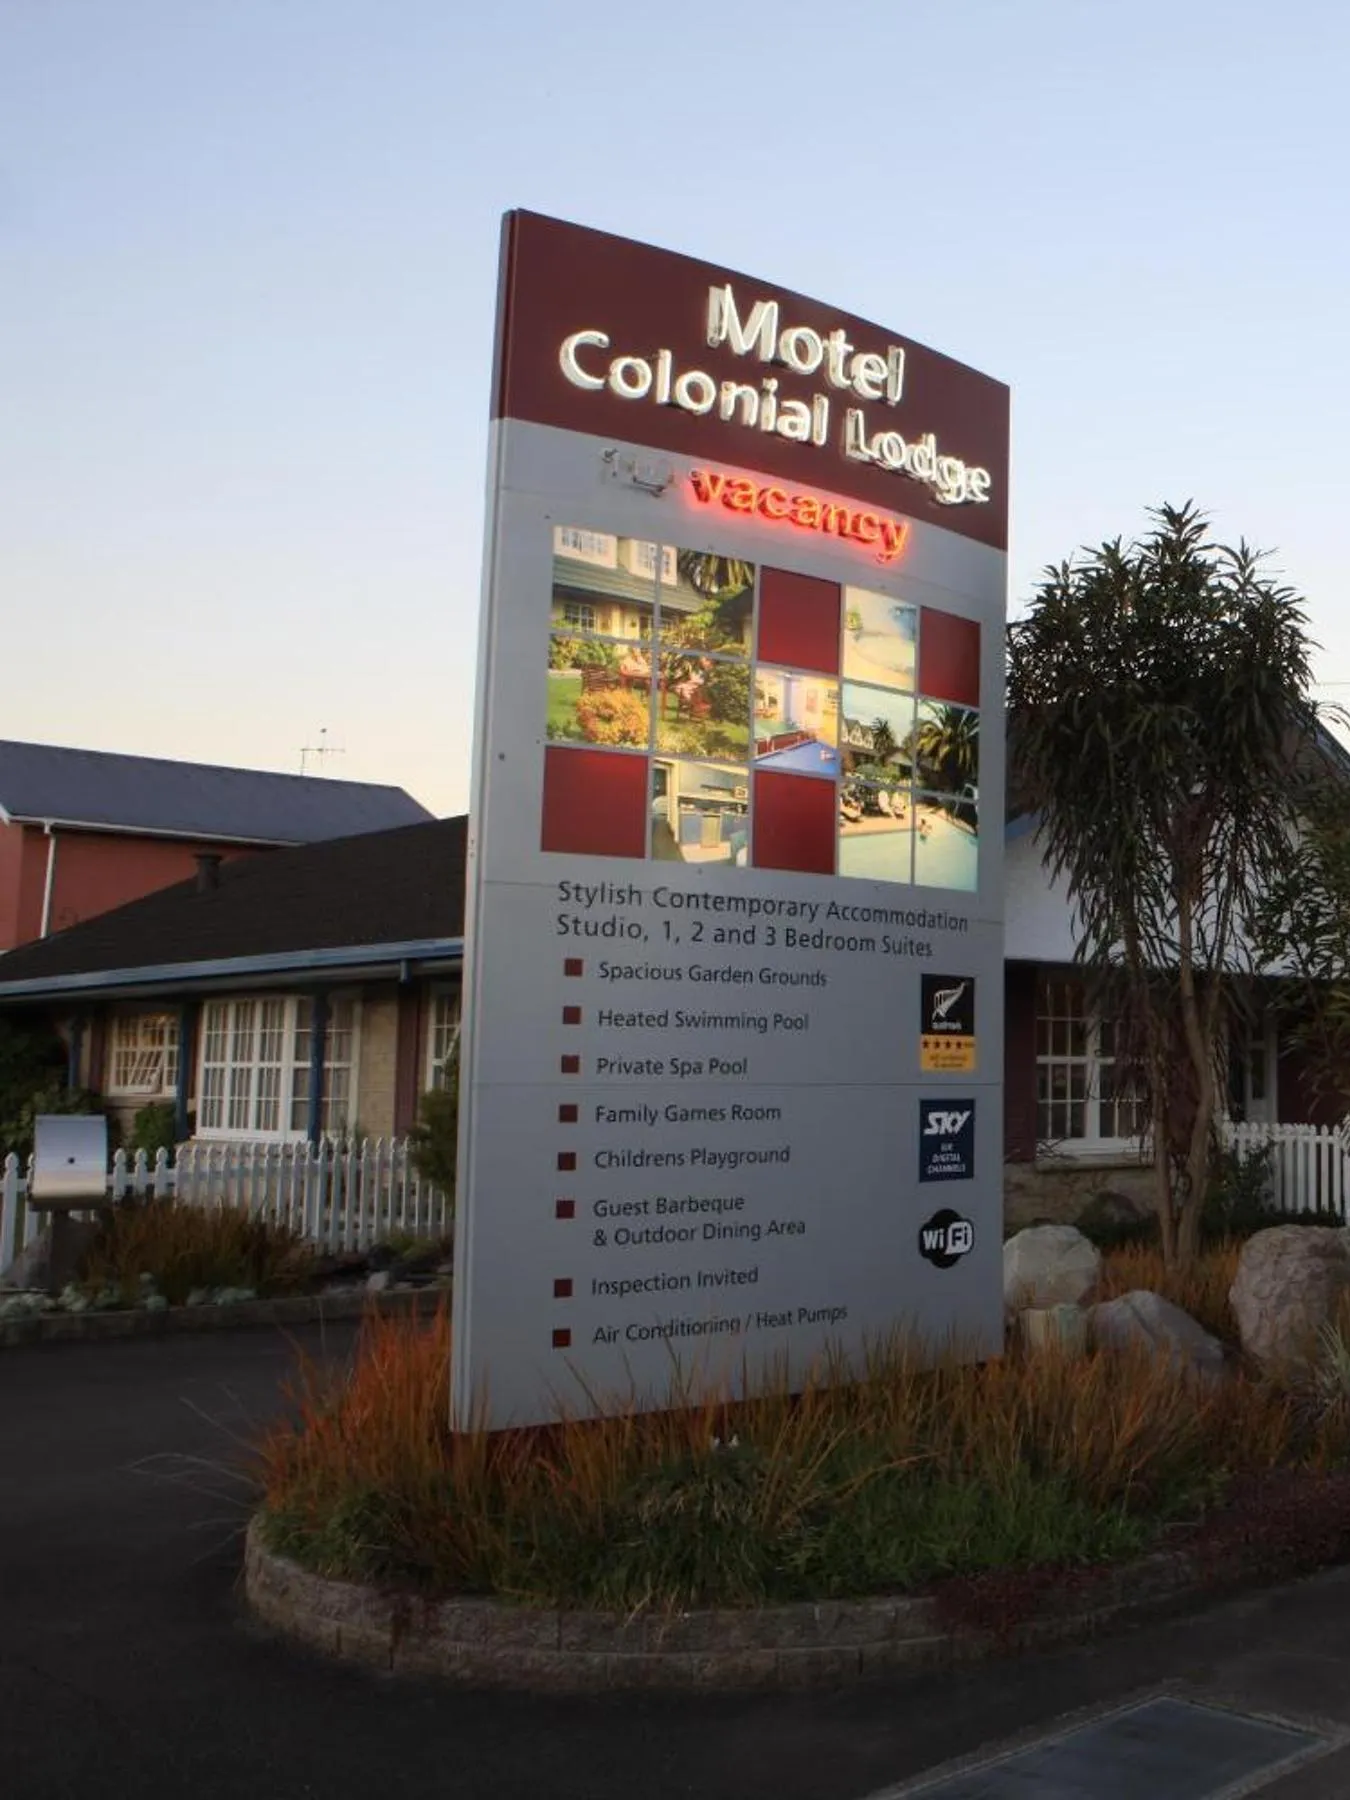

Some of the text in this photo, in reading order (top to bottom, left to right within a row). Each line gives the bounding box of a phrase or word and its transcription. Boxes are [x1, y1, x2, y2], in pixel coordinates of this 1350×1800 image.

[707, 285, 905, 406] Motel
[559, 330, 991, 505] Colonial Lodge
[689, 467, 910, 562] vacancy
[558, 880, 968, 932] Stylish Contemporary Accommodation
[557, 914, 933, 957] Studio, 1, 2 and 3 Bedroom Suites
[598, 961, 828, 987] Spacious Garden Grounds
[598, 1009, 809, 1034] Heated Swimming Pool
[596, 1057, 748, 1078] Private Spa Pool
[595, 1104, 781, 1126] Family Games Room
[923, 1111, 971, 1136] SKY
[594, 1146, 791, 1169] Childrens Playground
[593, 1195, 745, 1217] Guest Barbeque
[593, 1219, 806, 1246] & Outdoor Dining Area
[591, 1267, 759, 1298] Inspection Invited
[592, 1305, 848, 1345] Air Conditioning / Heat Pumps
